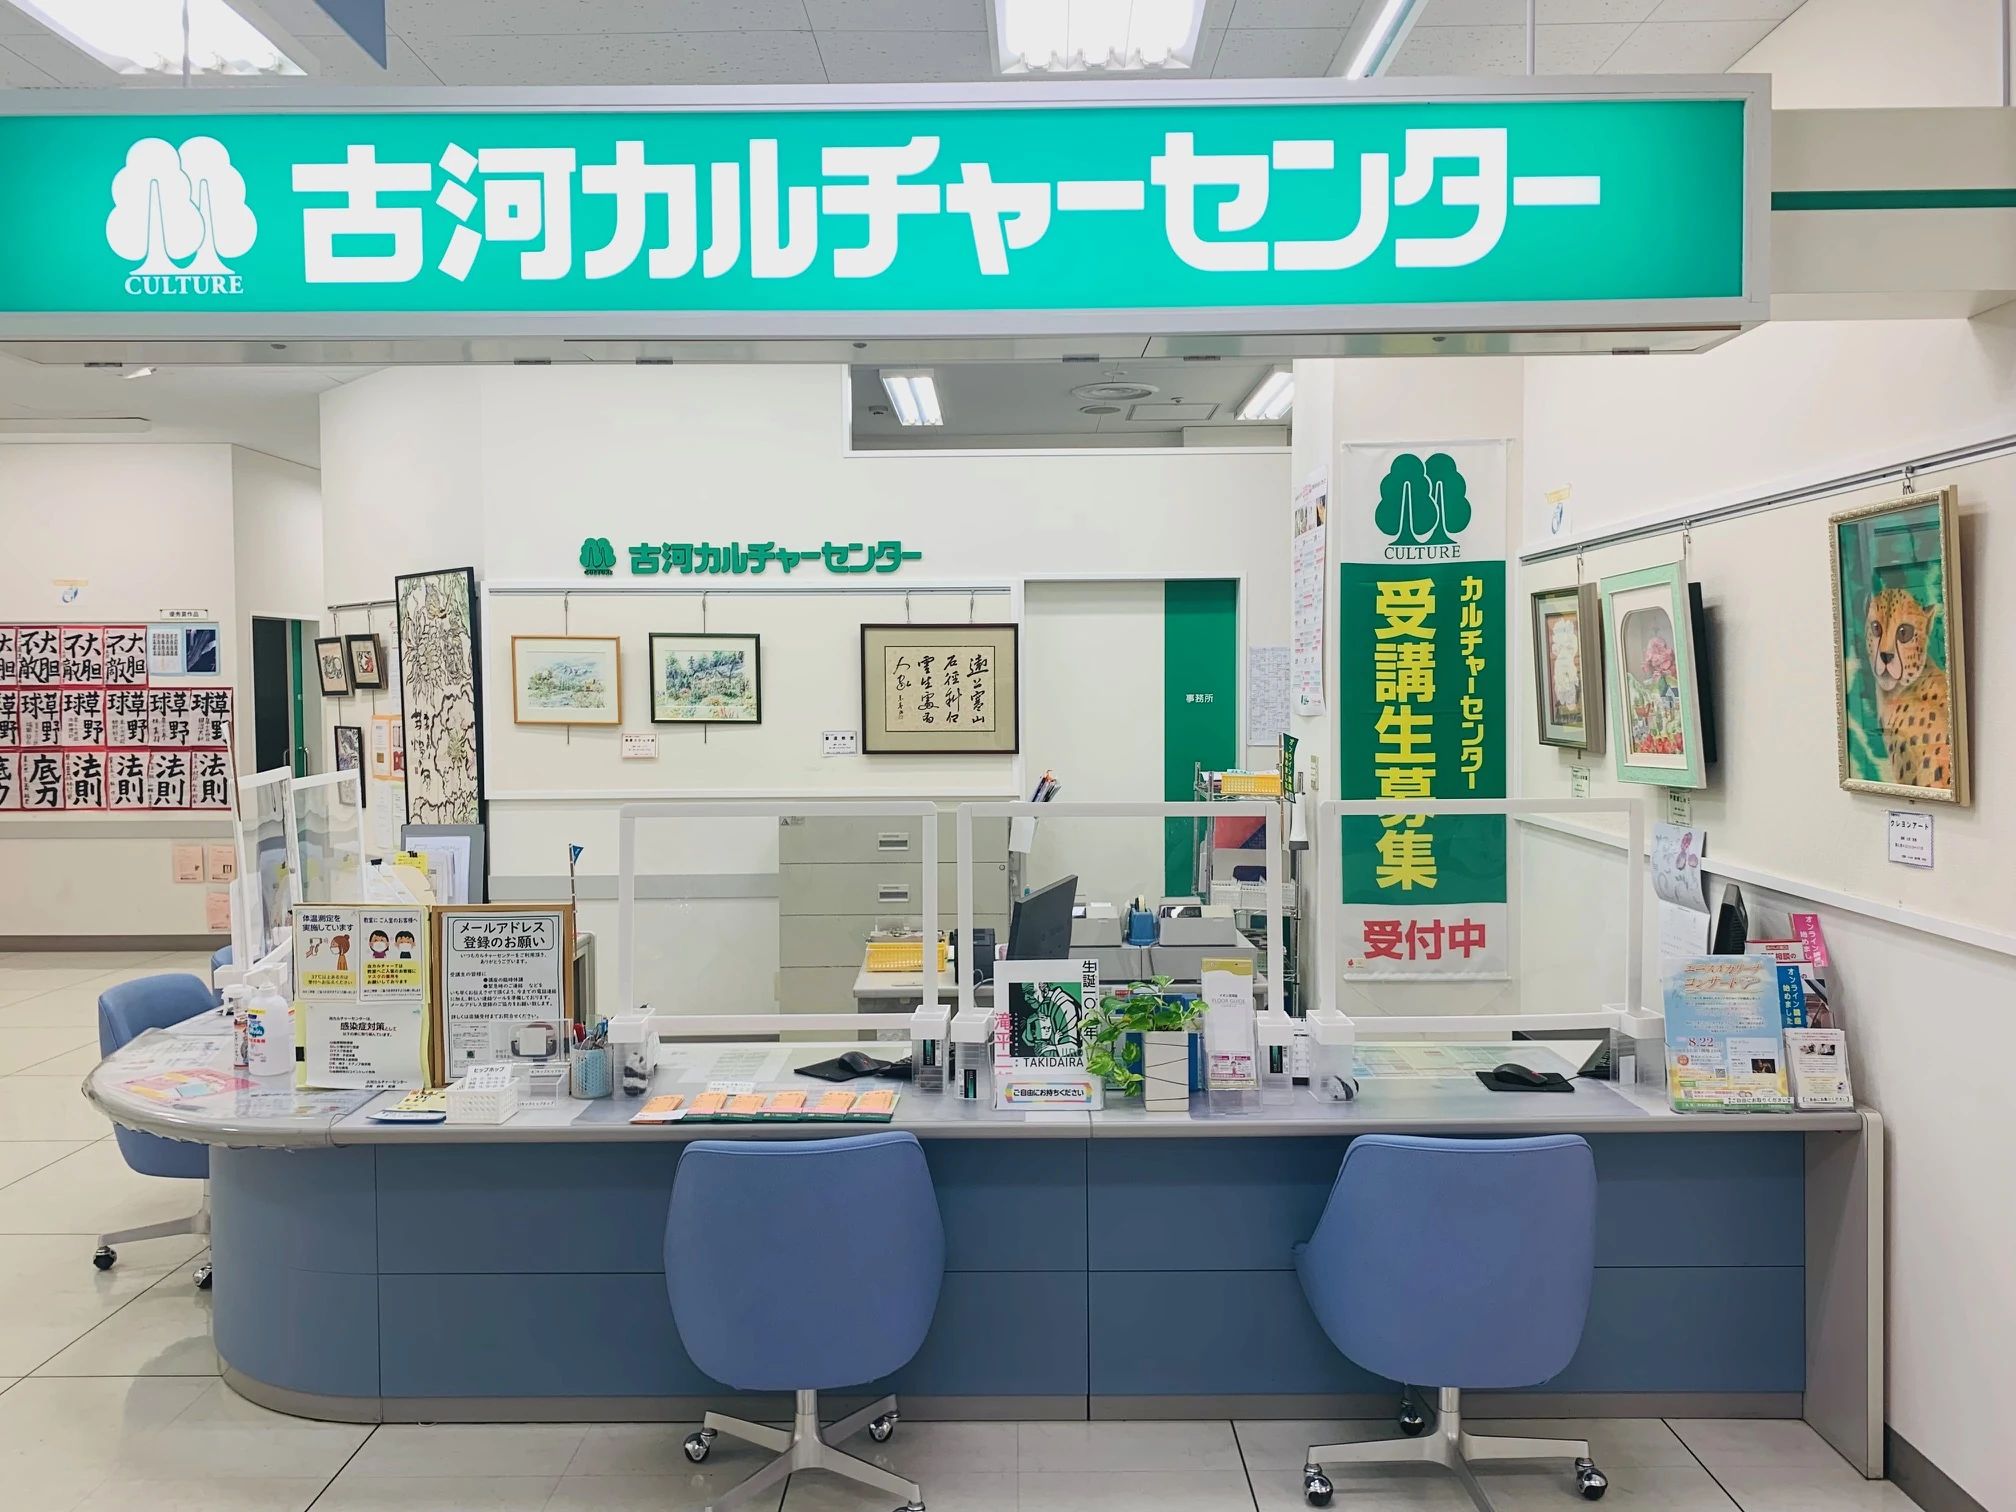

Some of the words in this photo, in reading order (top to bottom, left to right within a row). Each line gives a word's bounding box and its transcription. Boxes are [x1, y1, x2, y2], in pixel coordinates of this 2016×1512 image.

[291, 127, 1601, 284] 古河カルチャーセンター
[124, 274, 244, 296] CULTURE
[628, 540, 922, 575] 古河カルチャーセンター
[1384, 545, 1461, 560] CULTURE
[1185, 693, 1214, 703] 事務所
[1459, 575, 1485, 790] カルチャーセンター
[1374, 577, 1438, 891] 受講生募集
[72, 752, 102, 807] 法則
[115, 754, 144, 805] 法則
[154, 753, 186, 805] 法則
[200, 753, 229, 805] 法則
[302, 914, 341, 922] 体温測定を
[460, 922, 545, 934] メールアドレス
[1363, 918, 1487, 961] 受付中
[464, 935, 545, 949] 登録のお願い
[1082, 960, 1097, 1040] 生誕一〇年
[994, 1012, 1013, 1075] 滝平二
[1023, 1057, 1084, 1067] TAKIDAIRA
[1013, 1089, 1084, 1097] ご自由にお持ちください
